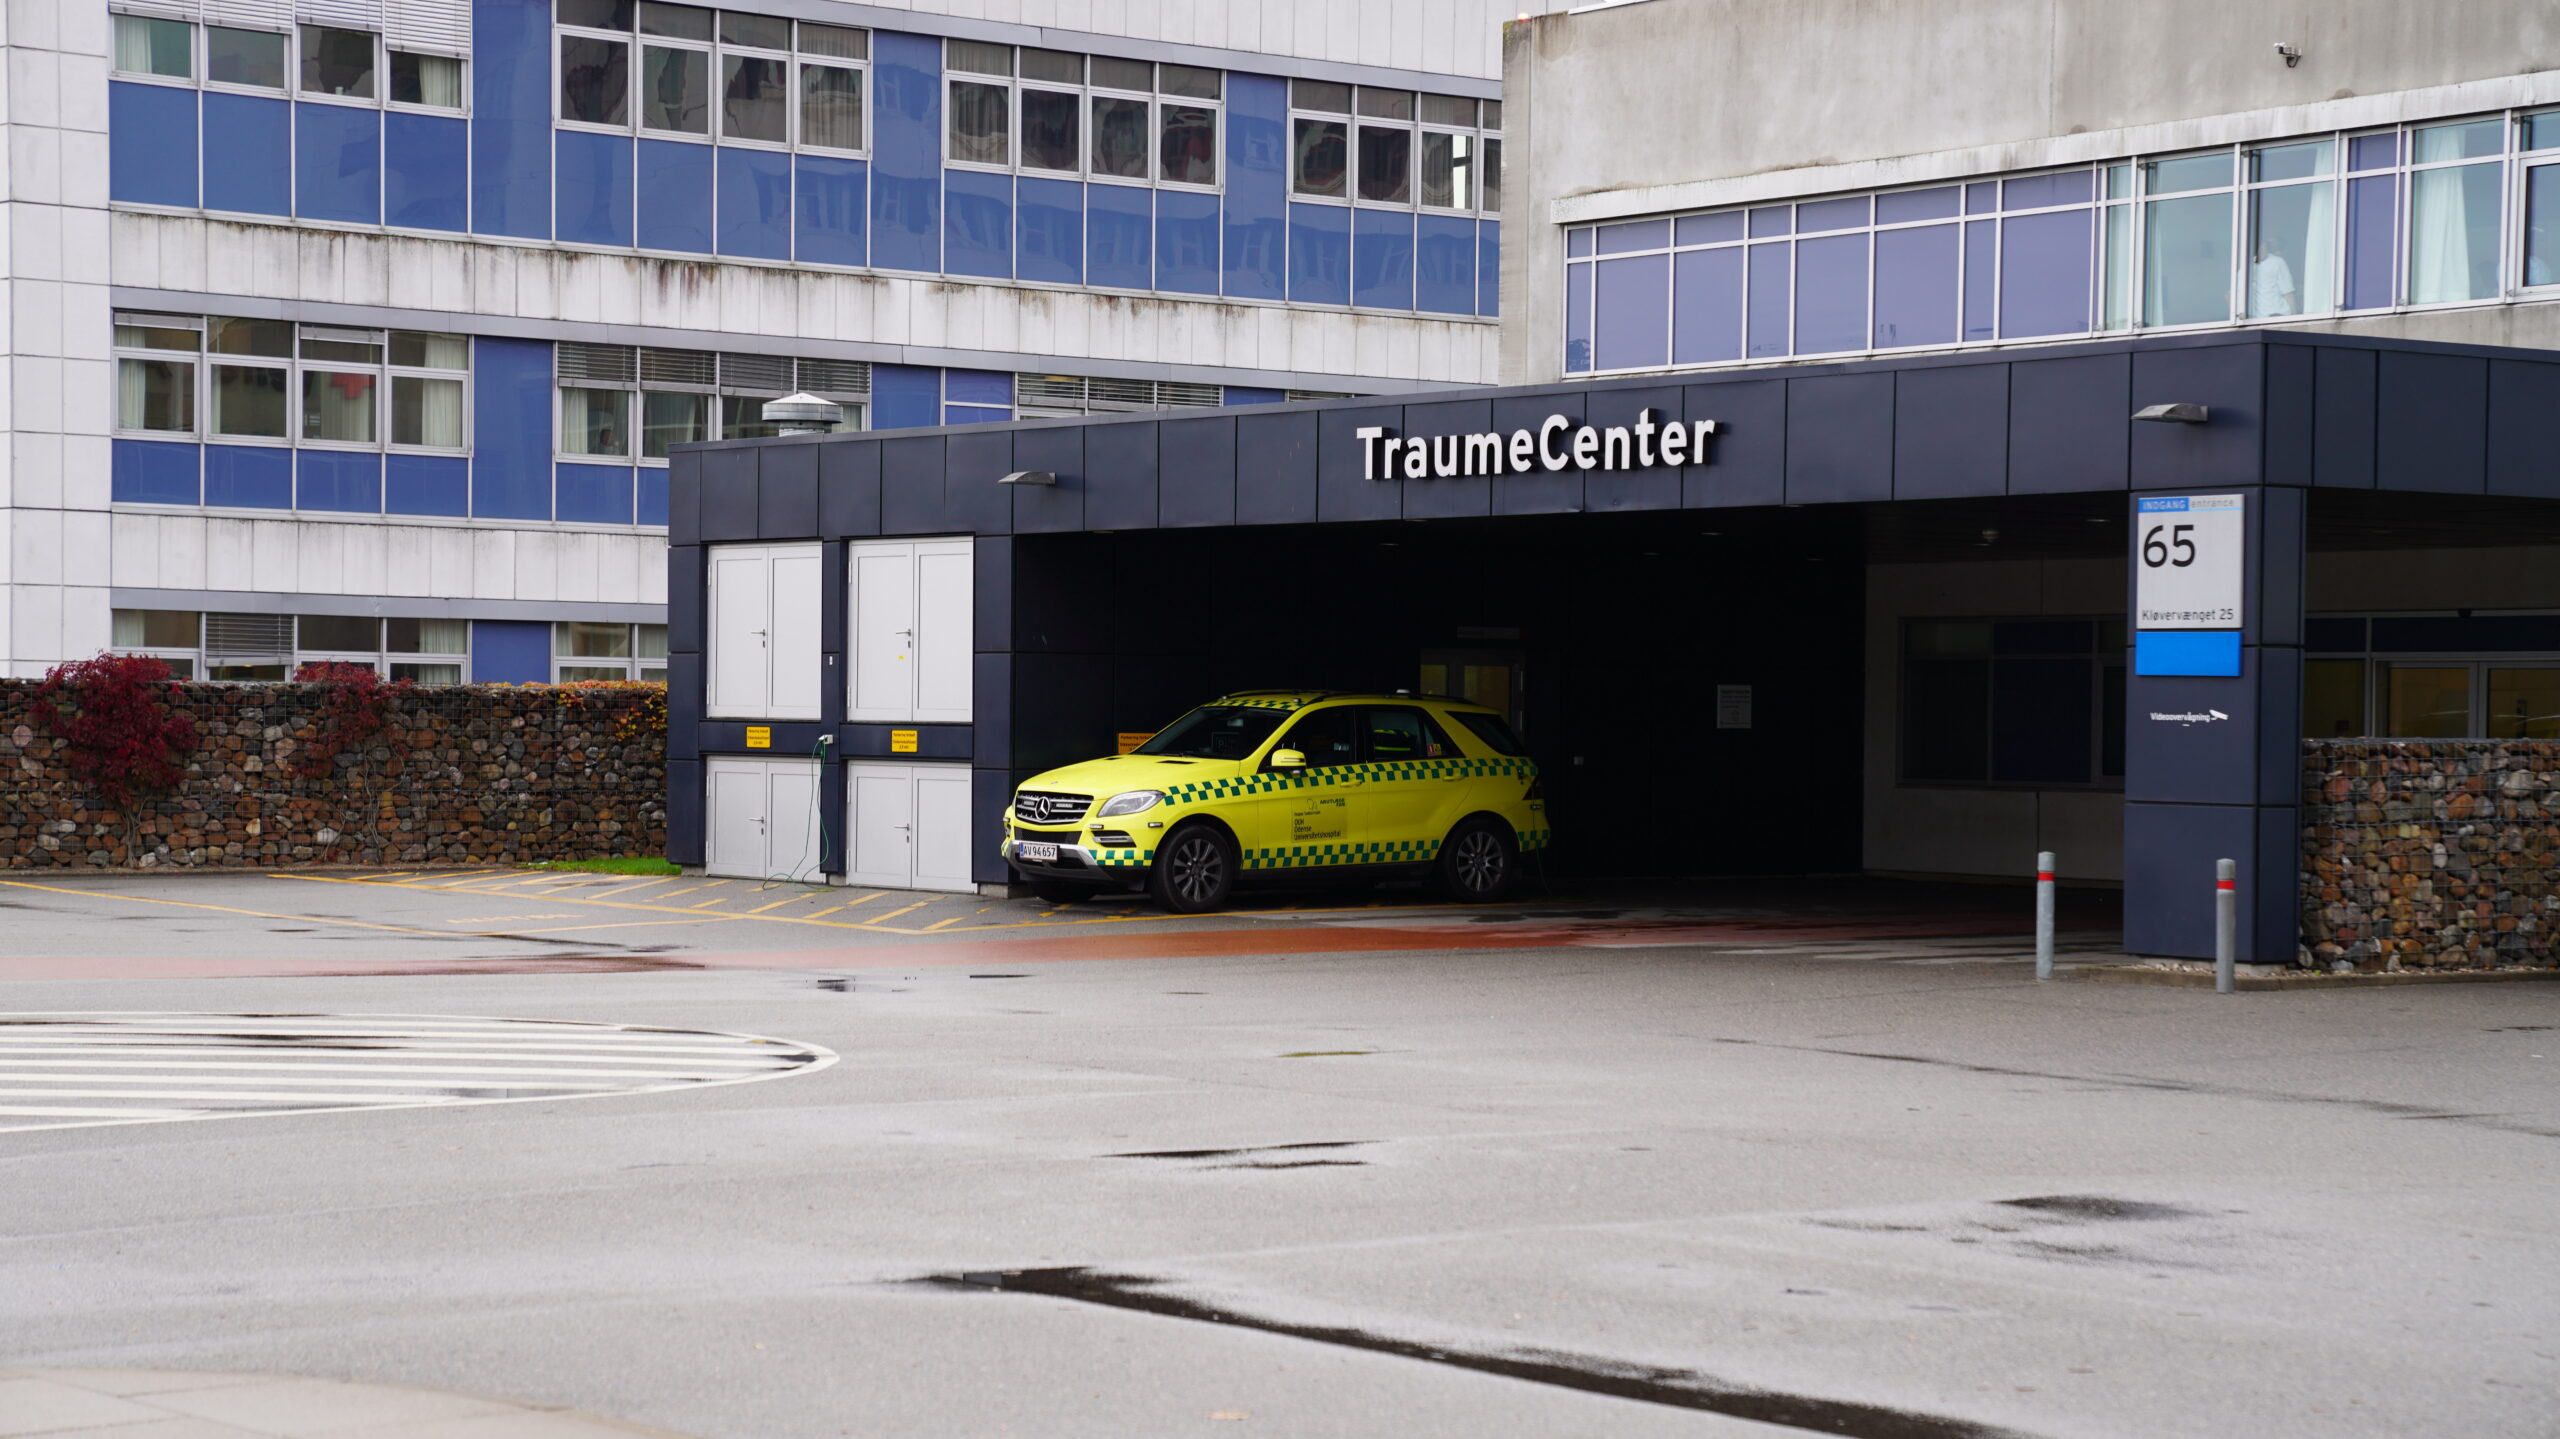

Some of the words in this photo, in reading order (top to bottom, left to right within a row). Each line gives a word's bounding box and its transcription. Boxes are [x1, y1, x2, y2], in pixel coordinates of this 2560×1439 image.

[1356, 408, 1716, 480] TraumeCenter
[2143, 500, 2186, 510] INDGANG
[2143, 524, 2195, 568] 65
[2142, 609, 2216, 623] Kløvervænget
[2219, 608, 2234, 620] 25
